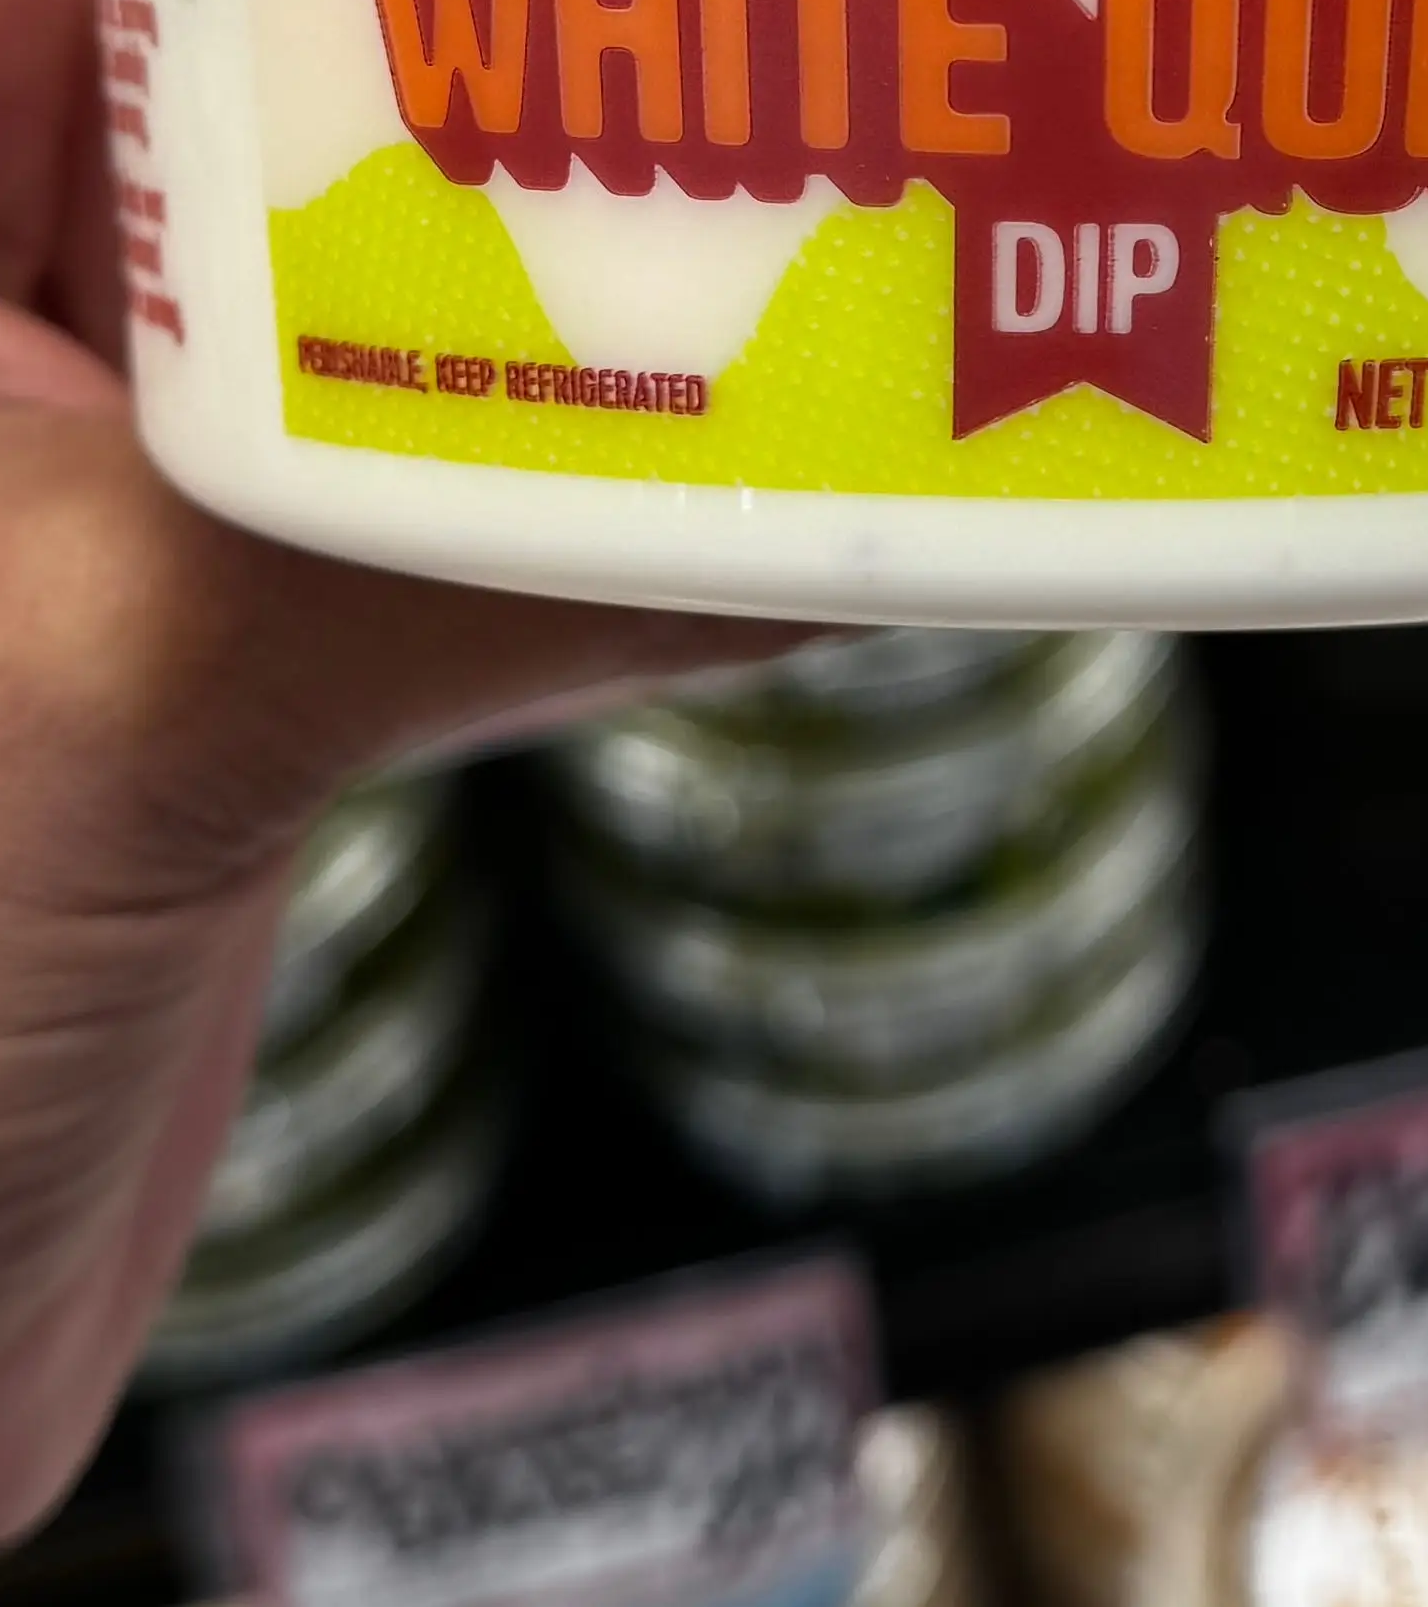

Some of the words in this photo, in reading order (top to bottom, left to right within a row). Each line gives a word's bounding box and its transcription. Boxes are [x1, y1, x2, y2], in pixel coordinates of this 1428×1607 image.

[990, 222, 1180, 334] DIP
[298, 334, 429, 394] PERISHABLE,
[435, 352, 496, 398] KEEP
[505, 362, 708, 416] REFRIGERATED
